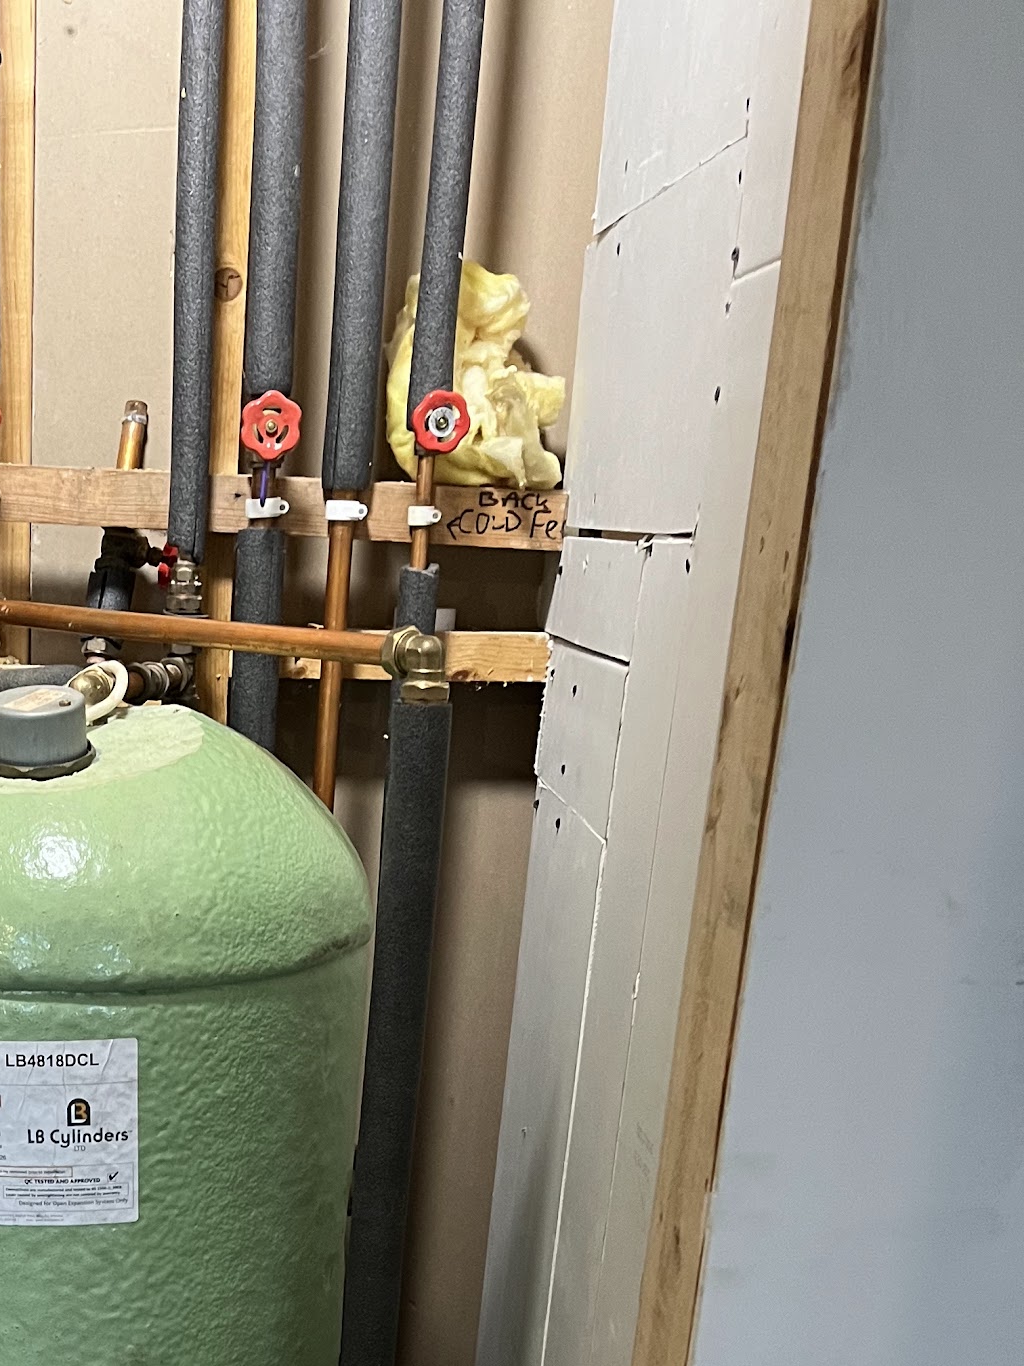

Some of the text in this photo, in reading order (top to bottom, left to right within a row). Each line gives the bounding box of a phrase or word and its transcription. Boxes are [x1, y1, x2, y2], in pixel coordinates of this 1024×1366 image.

[479, 491, 549, 511] BACK
[5, 1053, 100, 1068] LB4818DCL
[27, 1128, 129, 1148] LB Cylinders
